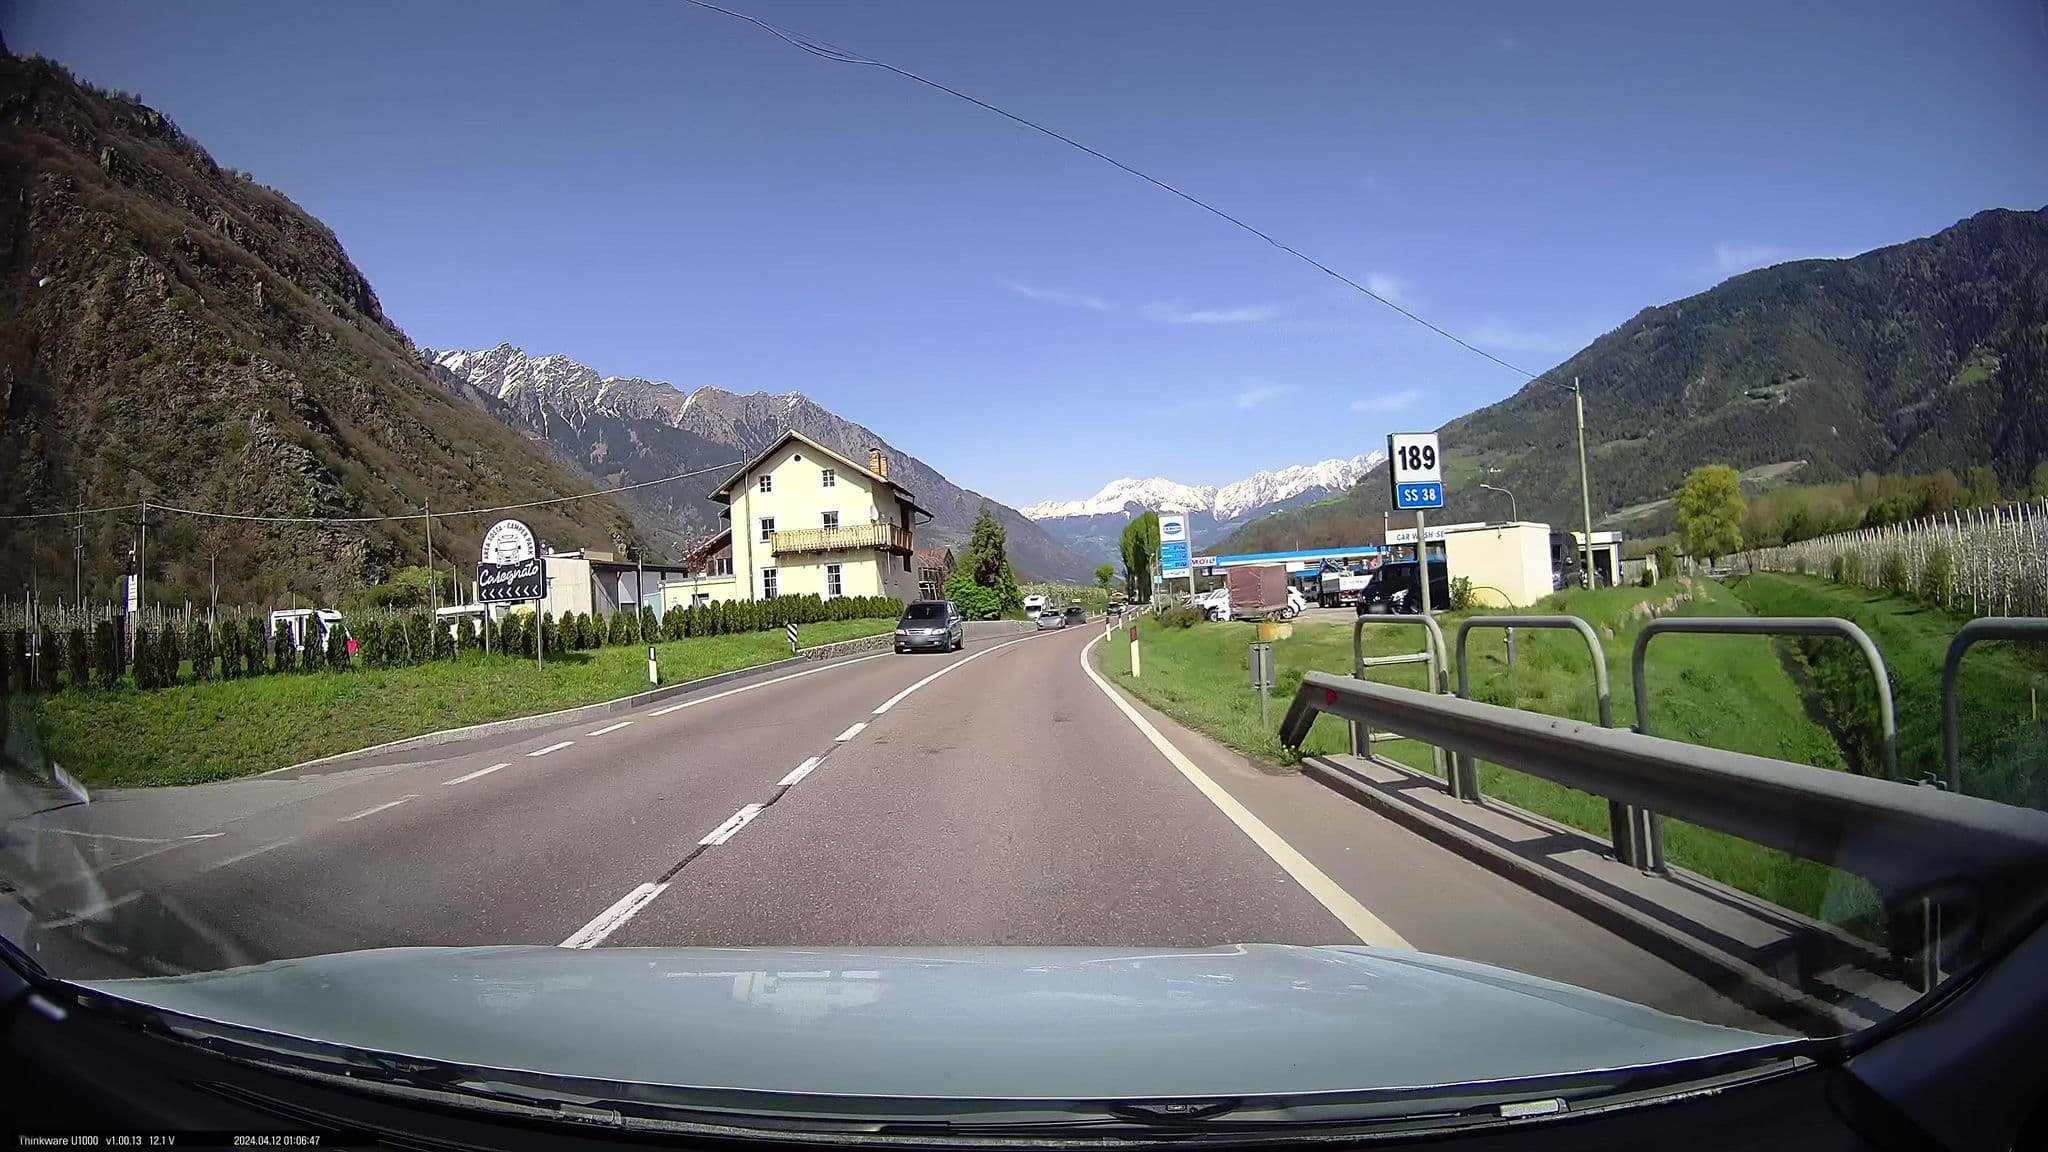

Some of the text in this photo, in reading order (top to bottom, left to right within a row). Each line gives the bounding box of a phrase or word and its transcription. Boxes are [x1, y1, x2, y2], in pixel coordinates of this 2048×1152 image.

[1398, 445, 1435, 470] 189
[1404, 488, 1437, 502] SS 38
[506, 522, 528, 539] CAMPER
[526, 537, 534, 555] PARK
[1396, 533, 1410, 541] CAR
[1412, 531, 1433, 540] WSH
[480, 561, 539, 586] Casegnato
